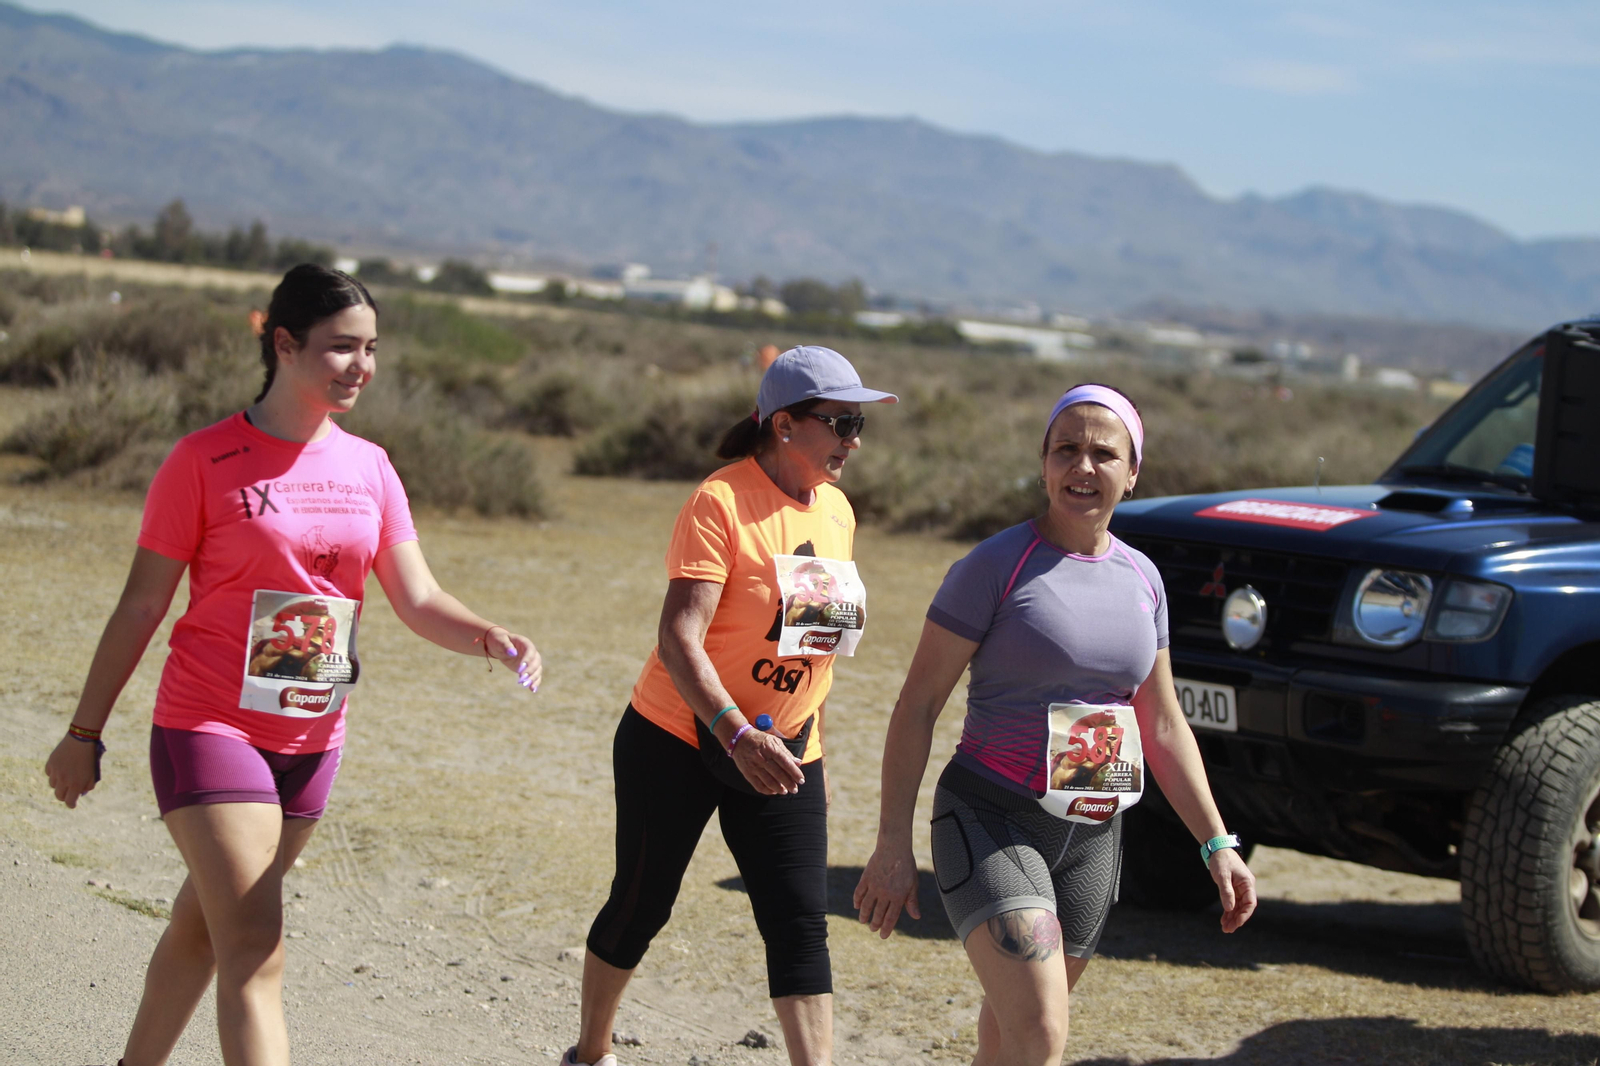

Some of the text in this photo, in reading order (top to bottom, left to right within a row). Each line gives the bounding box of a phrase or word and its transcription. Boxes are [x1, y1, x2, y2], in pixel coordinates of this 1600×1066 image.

[240, 484, 280, 519] IX
[273, 481, 324, 494] Carrera
[830, 601, 858, 611] XIII
[270, 612, 337, 655] 578
[751, 658, 805, 695] CASI
[1066, 725, 1124, 764] 587
[1105, 762, 1133, 772] XIII
